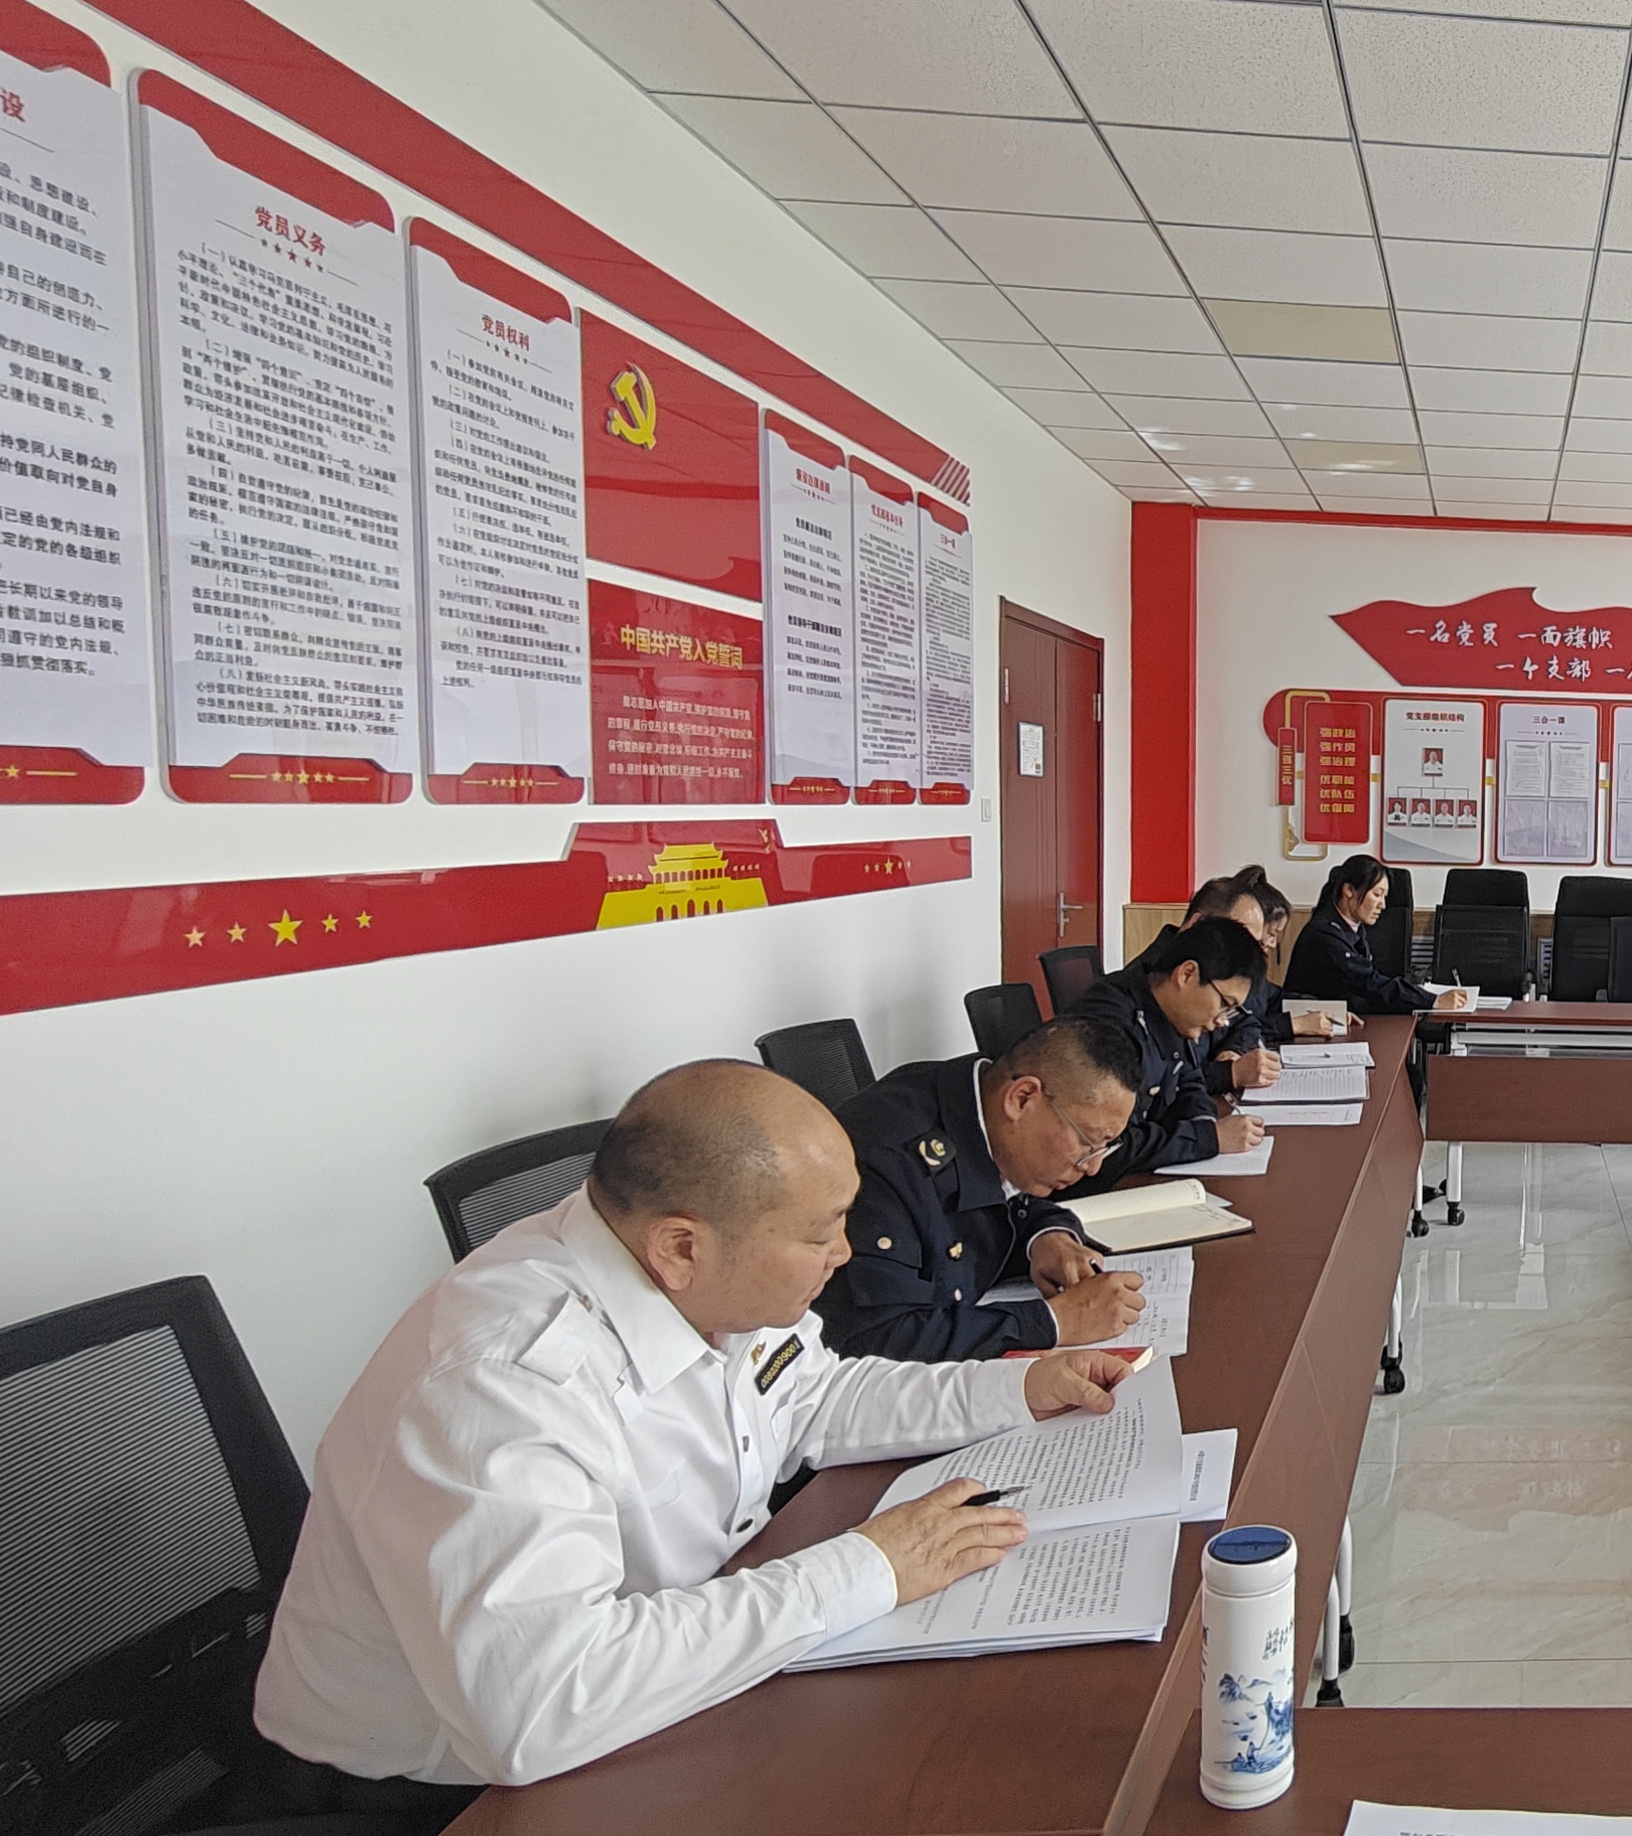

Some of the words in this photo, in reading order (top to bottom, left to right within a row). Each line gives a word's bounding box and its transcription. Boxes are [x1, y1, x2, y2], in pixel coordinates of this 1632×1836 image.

[255, 206, 326, 256] 党员义务
[0, 287, 109, 331] 方面所进行的一
[481, 314, 530, 351] 党员权利
[0, 505, 120, 541] 已经由党内法规和
[0, 531, 121, 565] 定的党的各级组织
[620, 624, 743, 670] 中国共产党入党誓词
[1406, 620, 1499, 647] 一名党员
[1517, 625, 1614, 650] 一面旗帜
[1496, 655, 1592, 681] 一个支部
[1532, 716, 1565, 724] 三会一课
